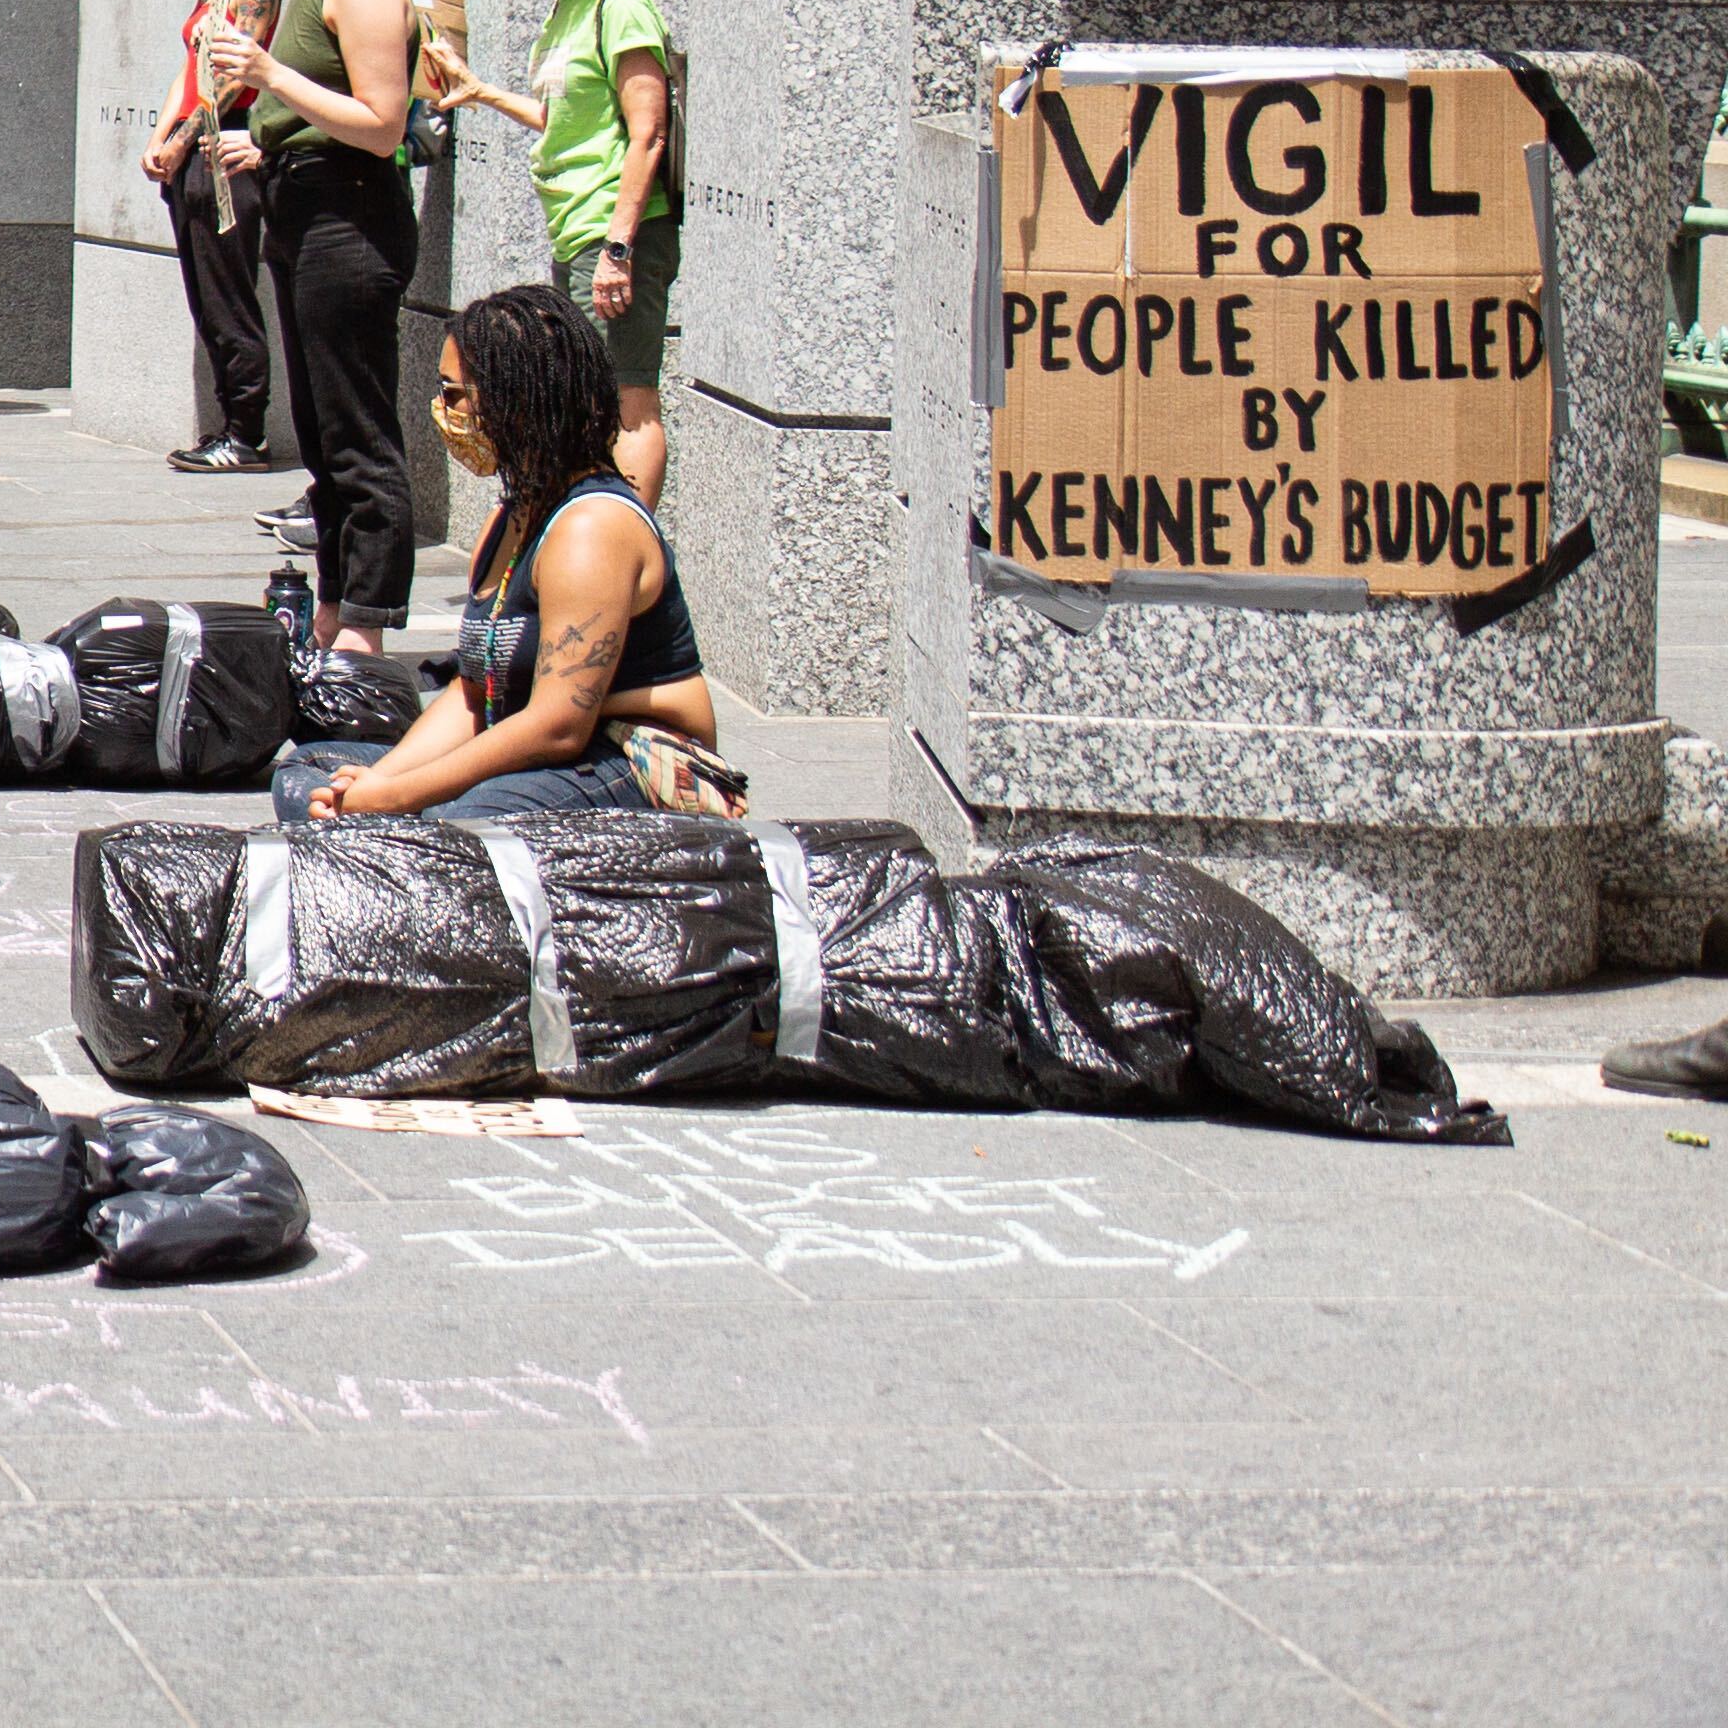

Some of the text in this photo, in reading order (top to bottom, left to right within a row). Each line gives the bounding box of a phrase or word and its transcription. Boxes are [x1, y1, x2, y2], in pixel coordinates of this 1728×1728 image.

[100, 105, 158, 127] NATIO
[1037, 85, 1481, 225] VIGIL
[1195, 218, 1372, 279] FOR
[1003, 291, 1255, 378] PEOPLE
[1314, 298, 1544, 382] KILLED
[1242, 387, 1326, 452] BY
[999, 462, 1547, 571] KENNEY'S BUDGET
[446, 1174, 1104, 1218] BUDGET
[400, 1219, 1251, 1282] DEADLY
